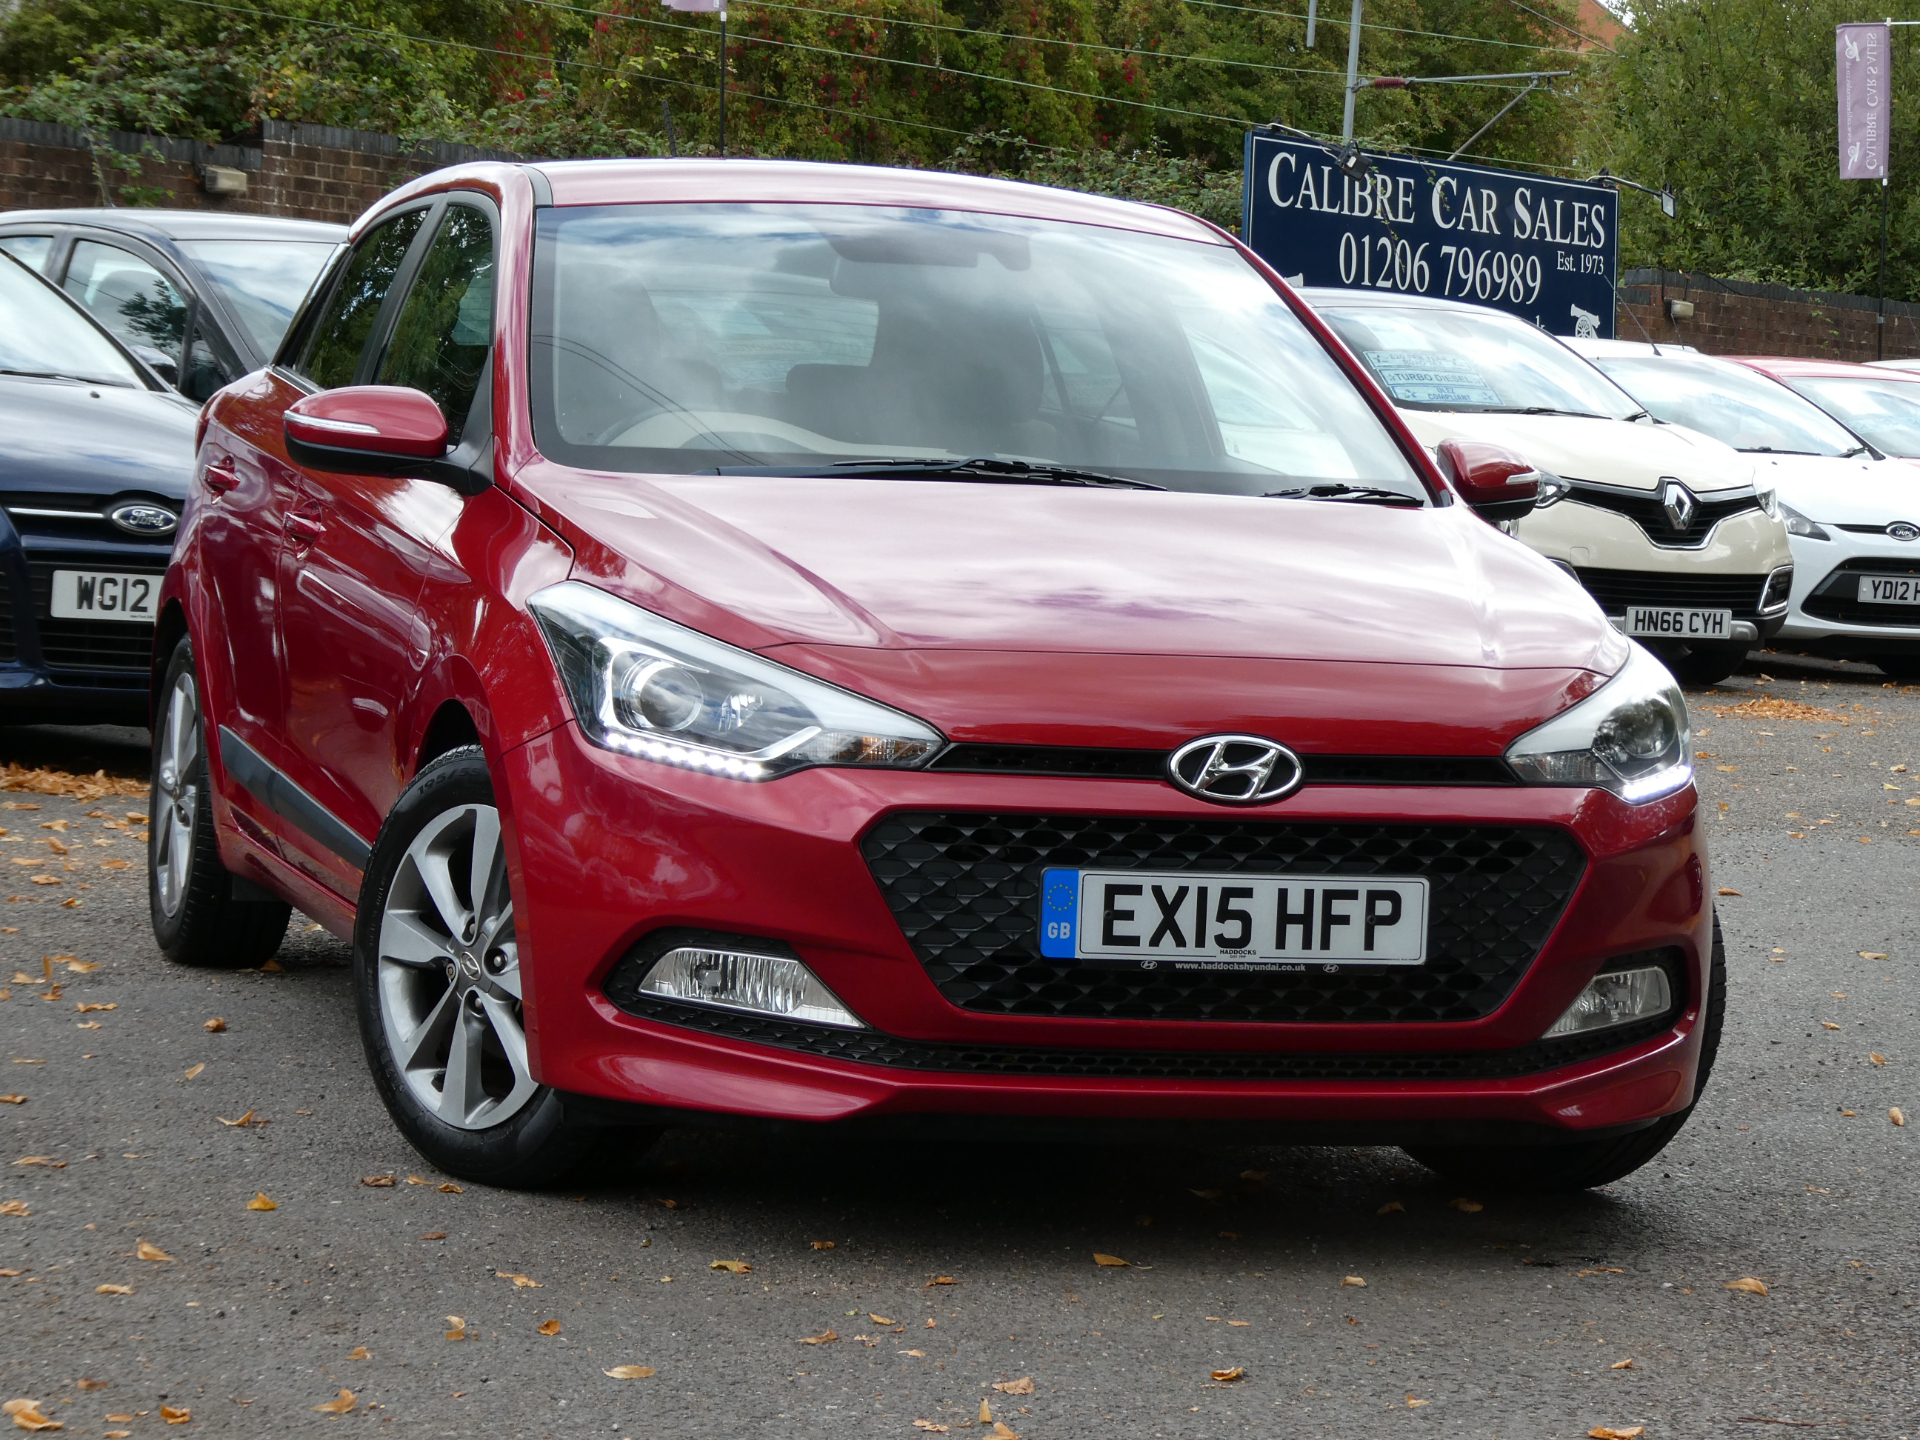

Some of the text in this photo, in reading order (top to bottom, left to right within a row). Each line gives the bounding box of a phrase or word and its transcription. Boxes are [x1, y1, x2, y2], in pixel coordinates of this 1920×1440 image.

[1267, 151, 1605, 249] CALIBRE CAR SALES
[1339, 231, 1542, 305] 01206 796989
[1556, 250, 1604, 275] Est. 1973
[1394, 373, 1473, 383] TURBO DIESEL
[1427, 393, 1472, 401] COMPLIANT
[129, 508, 164, 527] Ford
[76, 576, 150, 612] WG12
[1871, 580, 1909, 601] YD12
[1634, 610, 1724, 634] HN66 CYH
[1101, 883, 1403, 952] EX15 HFP
[1047, 921, 1071, 940] GB
[1174, 962, 1306, 972] www.haddockshyundai.co.uk
